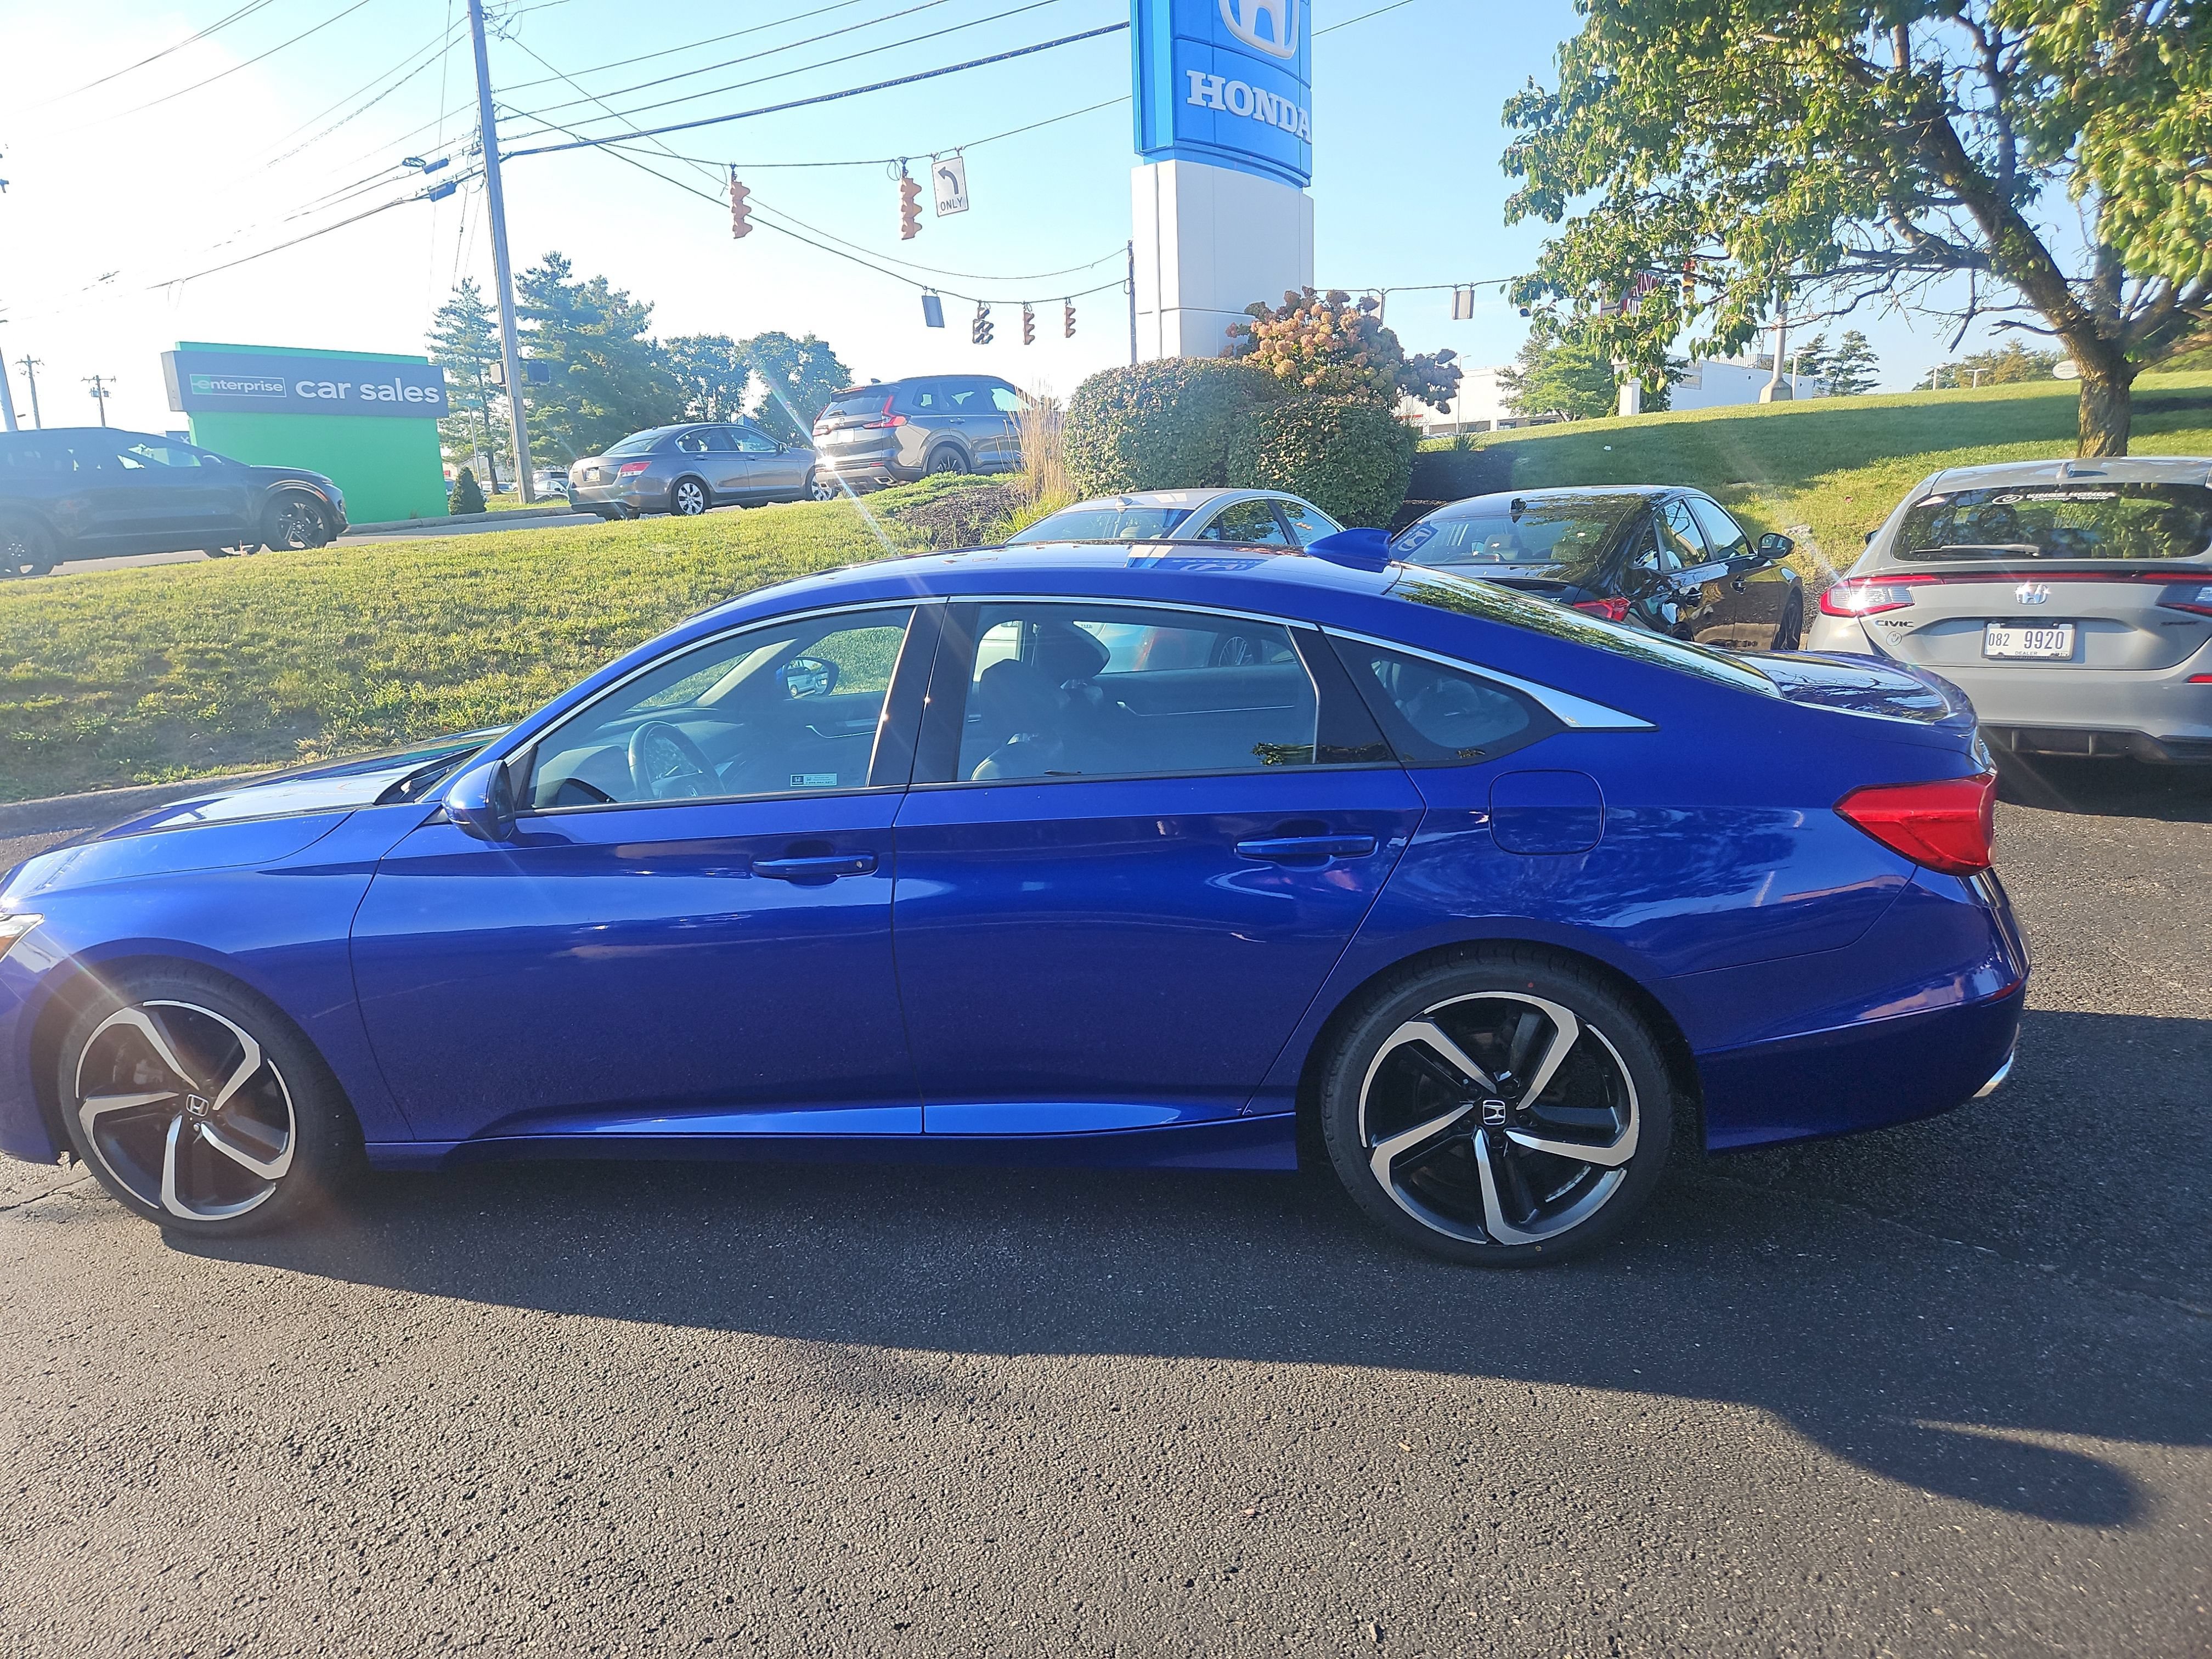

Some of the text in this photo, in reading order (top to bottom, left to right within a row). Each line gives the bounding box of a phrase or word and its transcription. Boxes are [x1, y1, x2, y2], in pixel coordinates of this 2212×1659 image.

[1186, 70, 1312, 144] HONDA
[940, 197, 963, 211] ONLY
[193, 377, 440, 403] enterprise car sales
[1988, 631, 2064, 650] 082 9920
